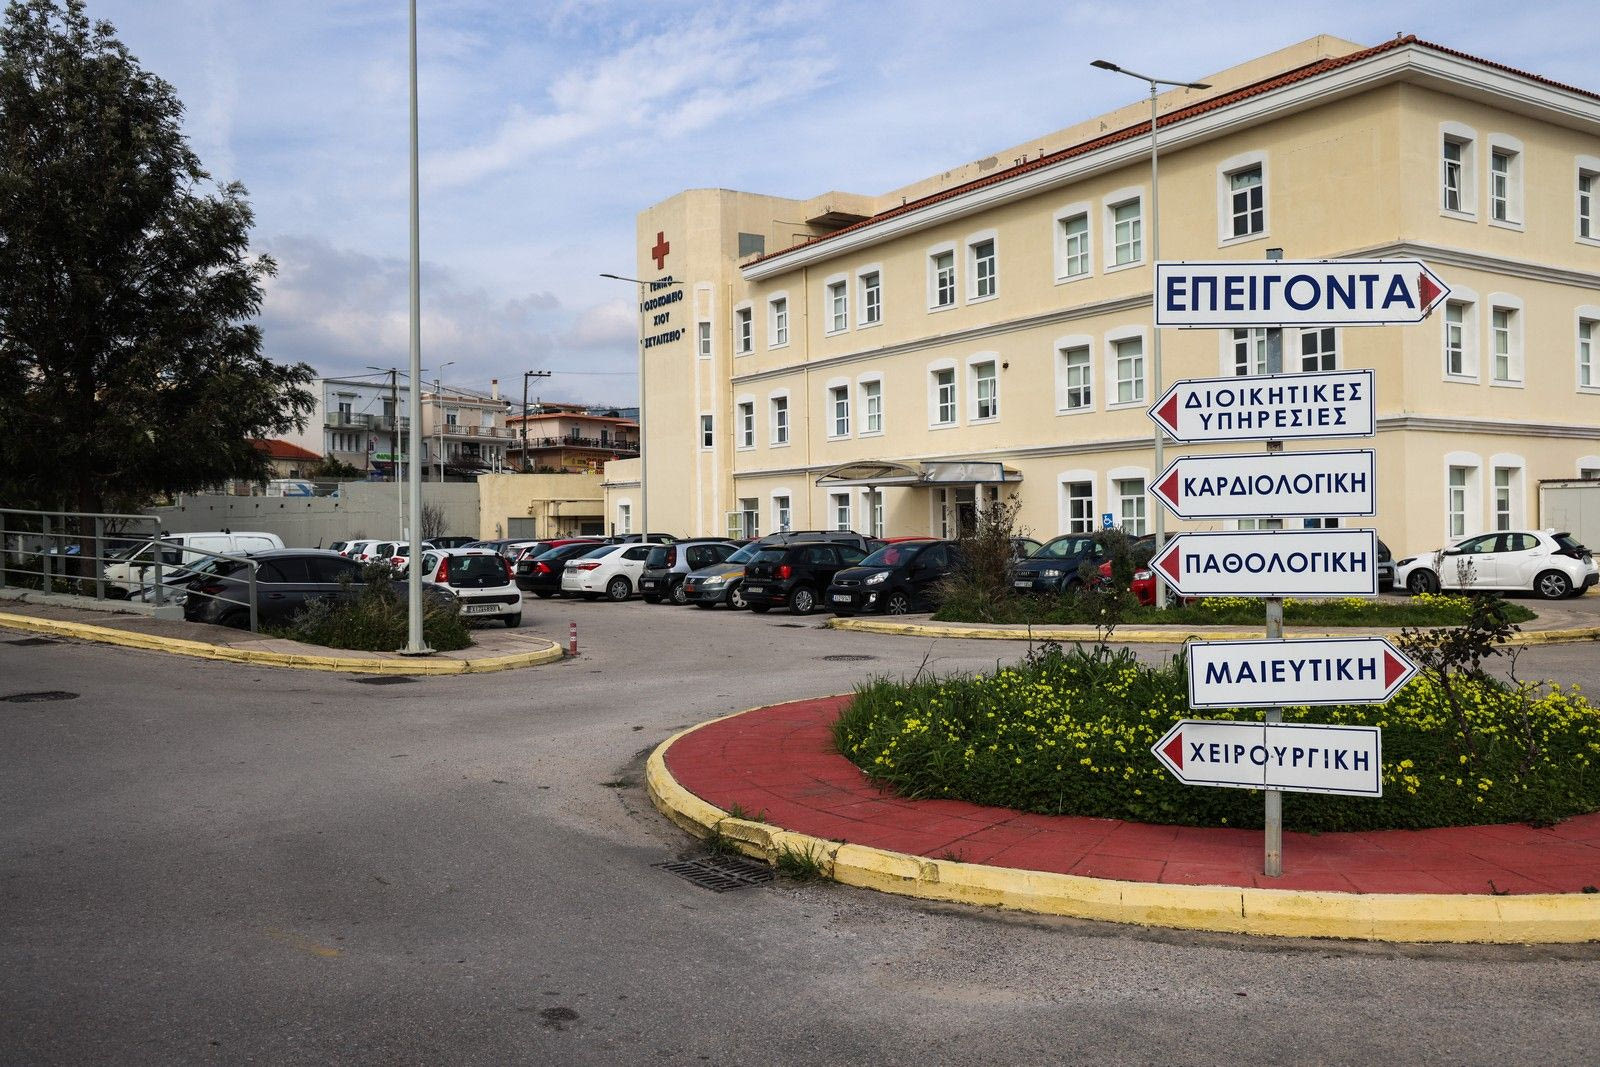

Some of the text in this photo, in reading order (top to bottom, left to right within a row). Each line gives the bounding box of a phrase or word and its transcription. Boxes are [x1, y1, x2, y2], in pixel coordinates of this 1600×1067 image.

[1166, 274, 1416, 311] ΕΠΕΙΓΟΝΤΑ
[653, 312, 670, 327] ΧΙΟΥ
[1184, 382, 1362, 409] ΔΙΟΙΚΗΤΙΚΕΣ
[1199, 407, 1347, 431] ΥΠΗΡΕΣΙΕΣ
[1184, 472, 1367, 497] ΚΑΡΔΙΟΛΟΓΙΚΗ
[1185, 551, 1367, 574] ΠΑΘΟΛΟΓΙΚΗ
[1205, 657, 1377, 685] ΜΑΙΕΥΤΙΚΗ
[1190, 742, 1369, 772] ΧΕΙΡΟΥΡΓΙΚΗ
